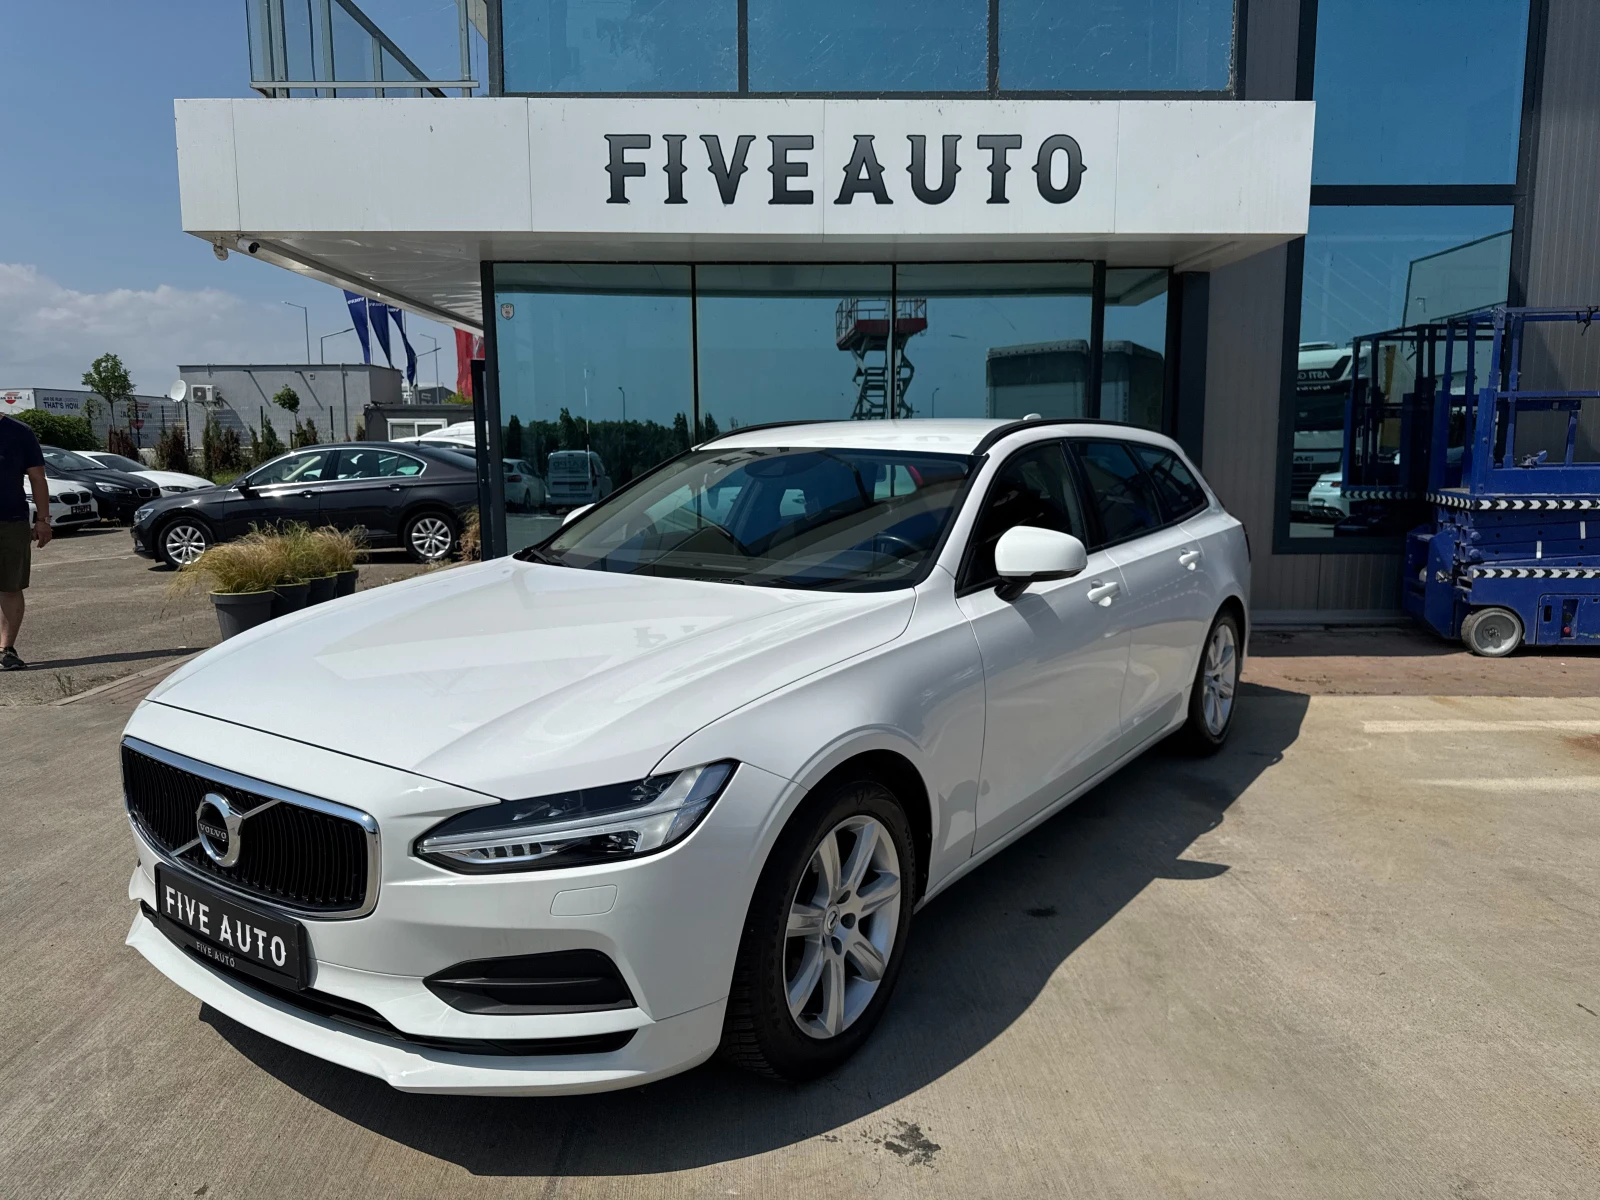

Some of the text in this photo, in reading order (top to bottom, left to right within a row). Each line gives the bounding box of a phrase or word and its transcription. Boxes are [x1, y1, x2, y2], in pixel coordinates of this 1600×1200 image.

[604, 134, 1088, 205] FIVE AUTO
[43, 401, 65, 409] THAT'S
[199, 822, 227, 839] VOLVO
[165, 885, 287, 967] FIVE AUTO
[196, 941, 236, 968] FIVE AUTO
